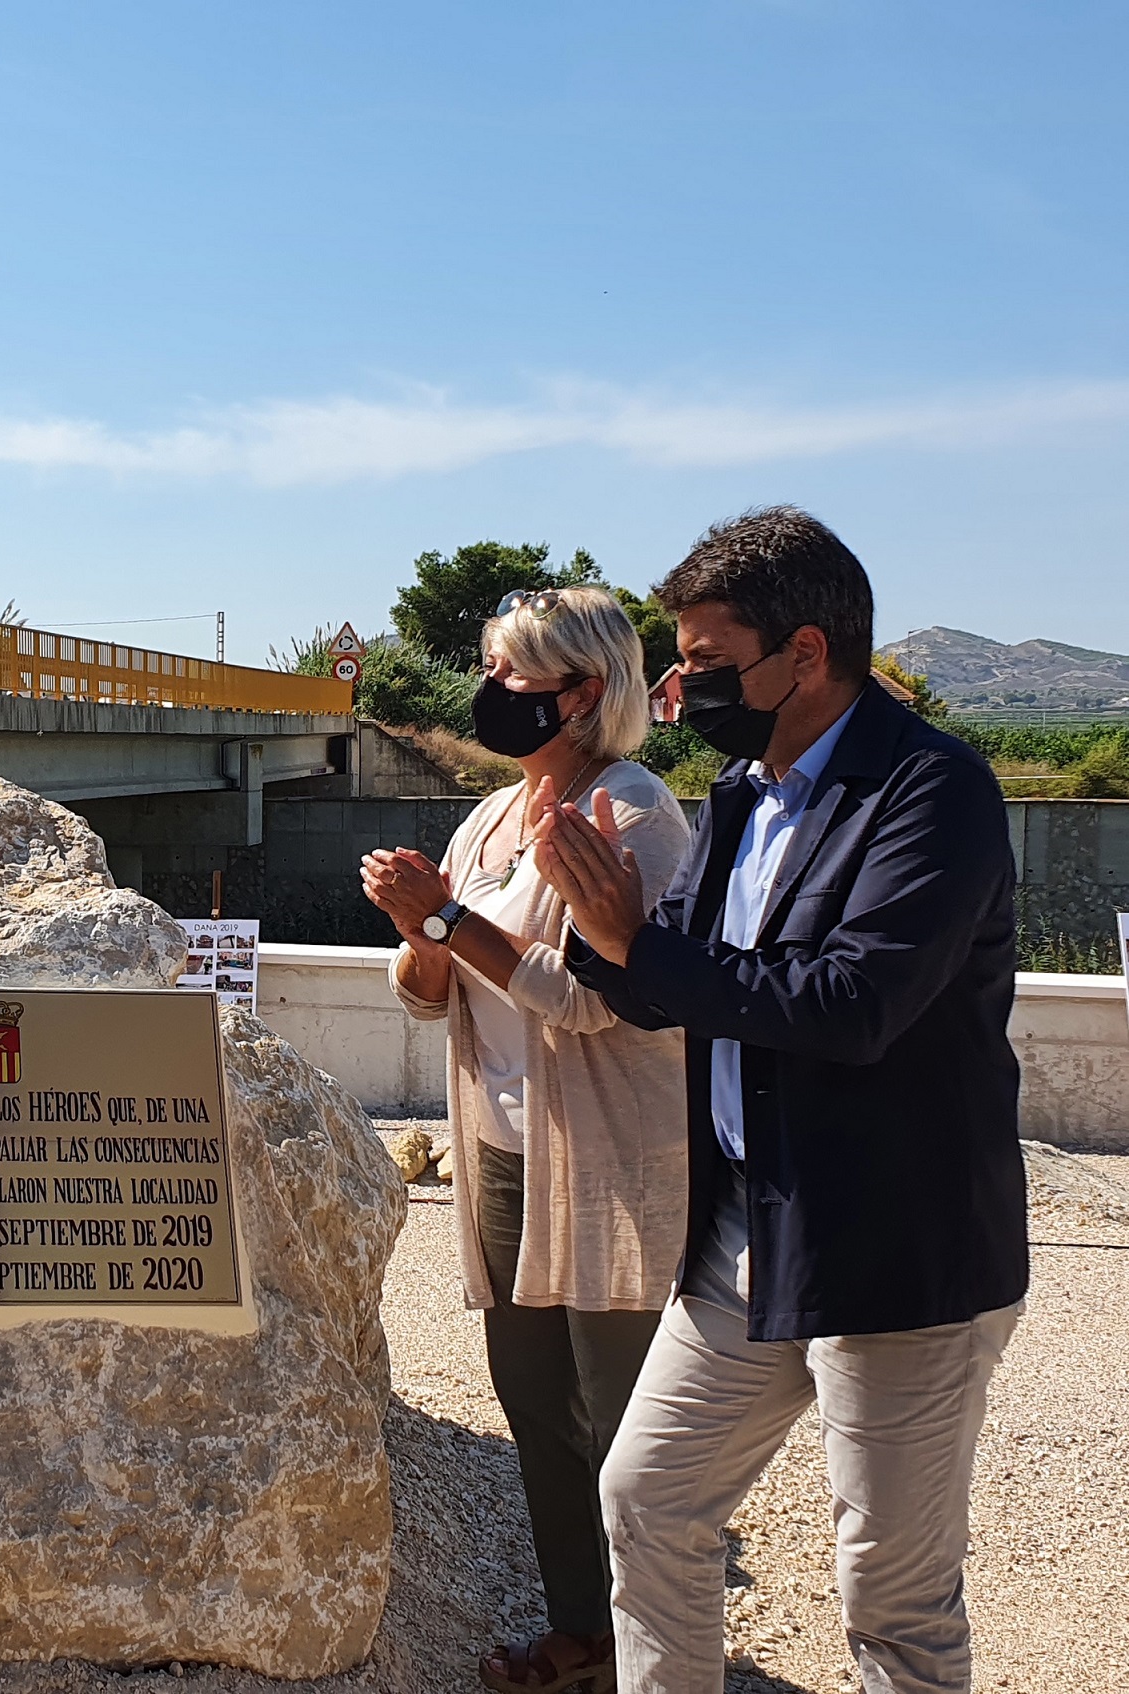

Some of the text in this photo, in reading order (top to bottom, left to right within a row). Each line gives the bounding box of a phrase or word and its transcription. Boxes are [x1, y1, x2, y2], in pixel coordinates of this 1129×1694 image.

[339, 665, 353, 674] 60
[28, 1087, 101, 1123] HÉROES
[107, 1098, 142, 1126] QUE,
[146, 1098, 168, 1123] DE
[172, 1098, 210, 1123] UNA
[56, 1136, 88, 1163] LAS
[94, 1137, 219, 1164] CONSECUENCIAS
[54, 1177, 123, 1204] NUESTRA
[131, 1177, 218, 1205] LOCALIDAD
[132, 1220, 157, 1246] DE
[162, 1214, 212, 1246] 2019
[108, 1262, 134, 1290] DE
[142, 1257, 203, 1290] 2020
